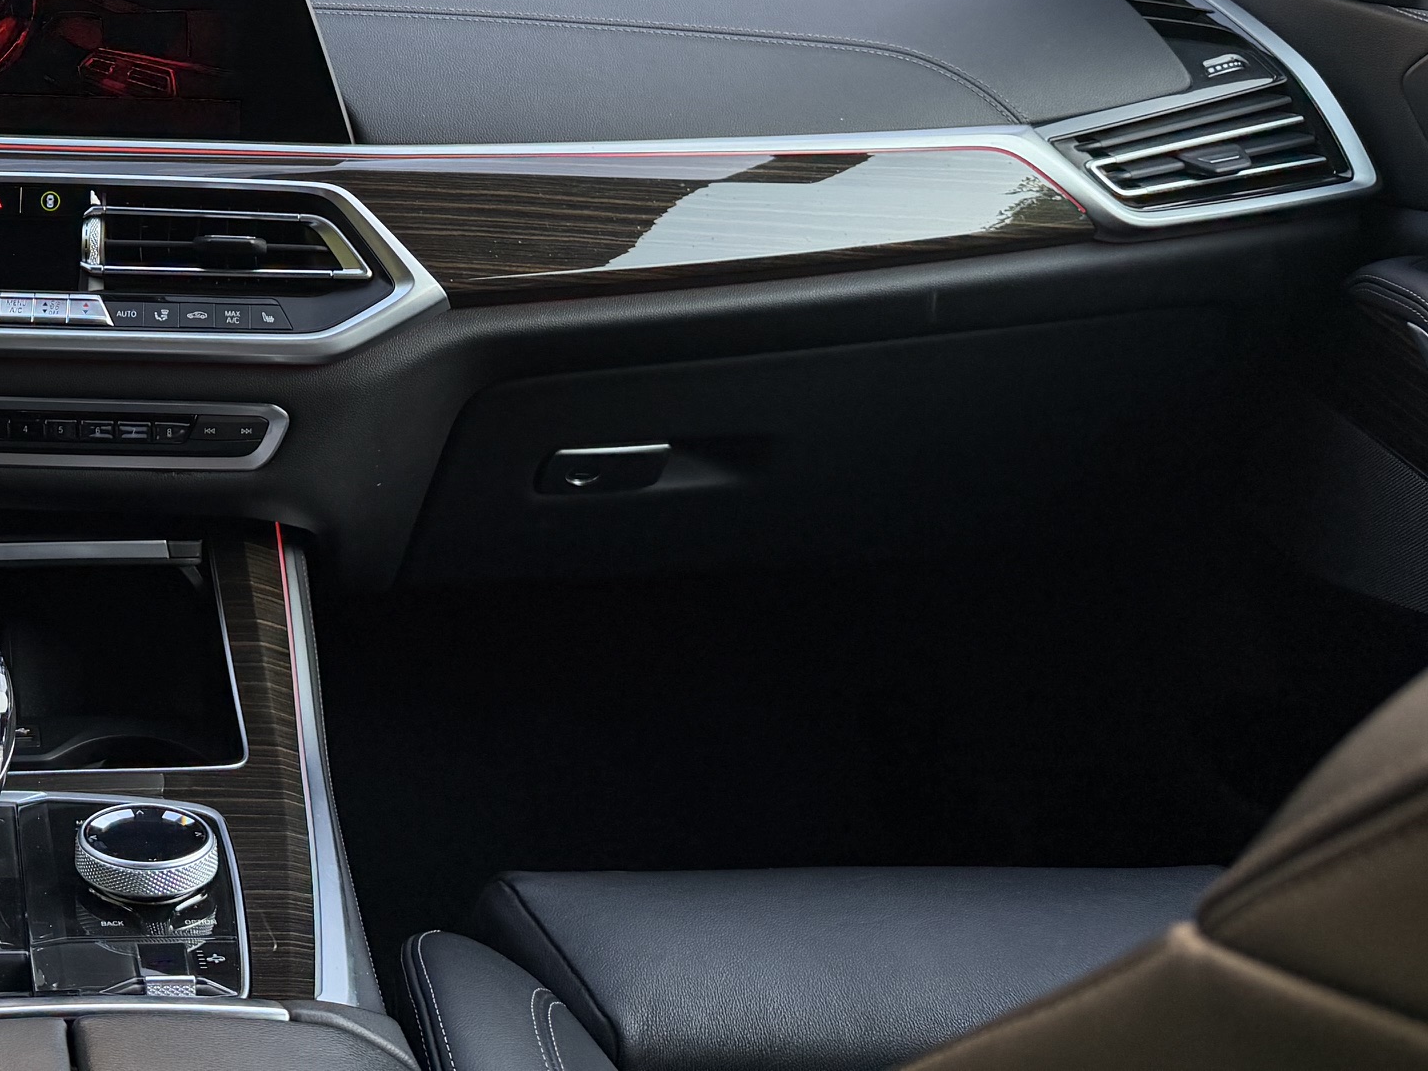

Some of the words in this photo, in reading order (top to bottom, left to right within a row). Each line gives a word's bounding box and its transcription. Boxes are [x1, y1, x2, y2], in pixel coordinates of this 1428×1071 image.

[5, 299, 27, 307] MENU
[9, 307, 23, 315] A/C
[115, 309, 138, 319] AUTO
[224, 309, 241, 317] MAX
[226, 316, 241, 324] A/C
[22, 425, 28, 433] 4
[58, 425, 64, 434] 5
[95, 426, 101, 435] 6
[166, 428, 172, 438] 8
